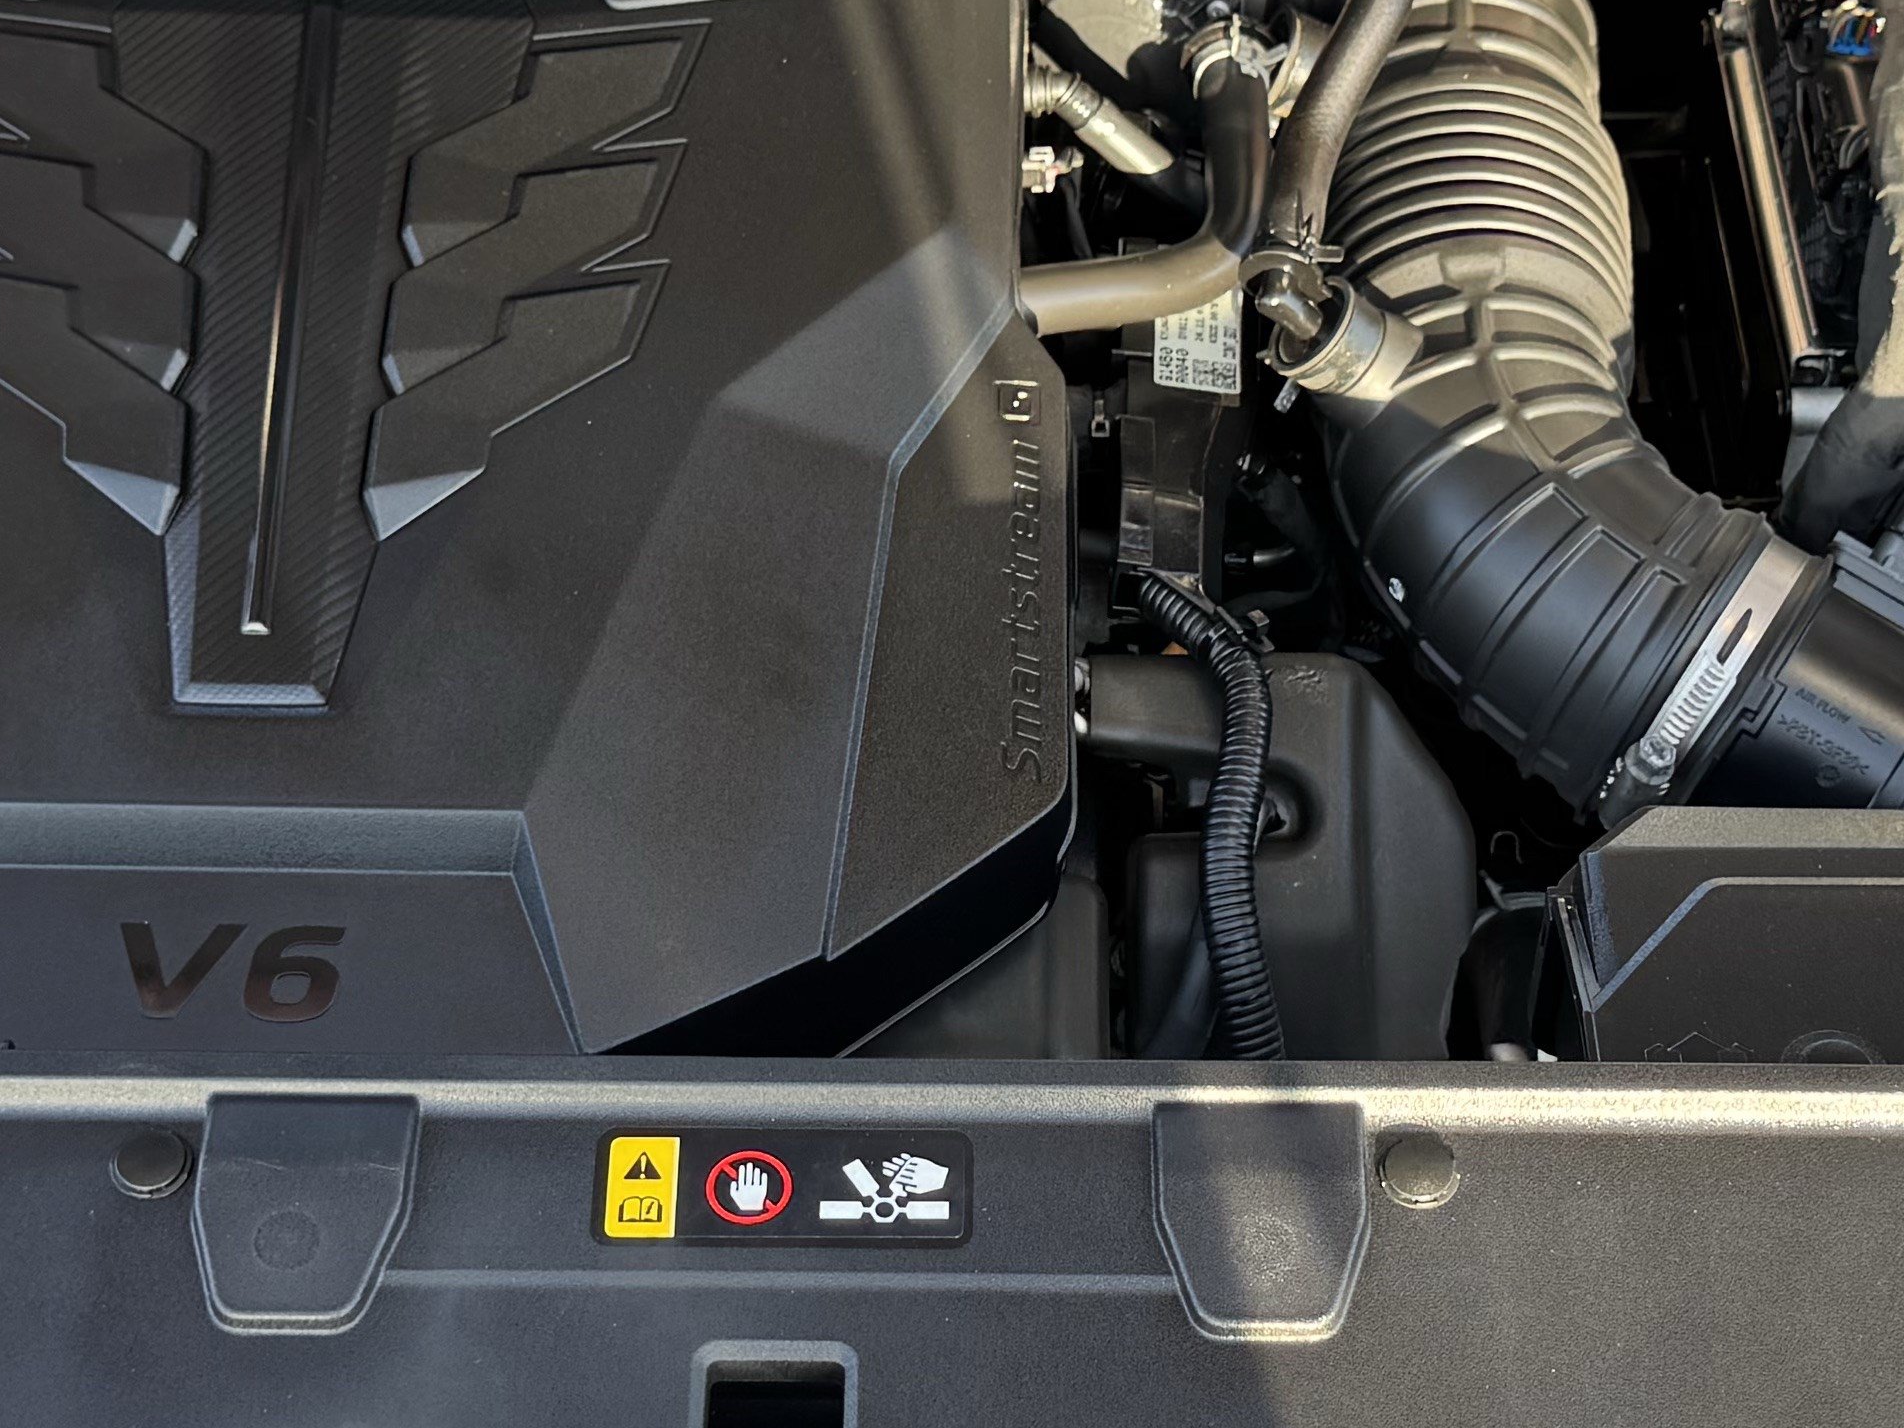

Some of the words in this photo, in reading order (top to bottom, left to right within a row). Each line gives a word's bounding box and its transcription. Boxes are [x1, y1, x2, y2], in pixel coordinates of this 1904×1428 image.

[1001, 438, 1042, 784] Smartstream
[1795, 687, 1817, 707] AIR
[1814, 699, 1852, 723] FLOW
[119, 922, 347, 1024] V6
